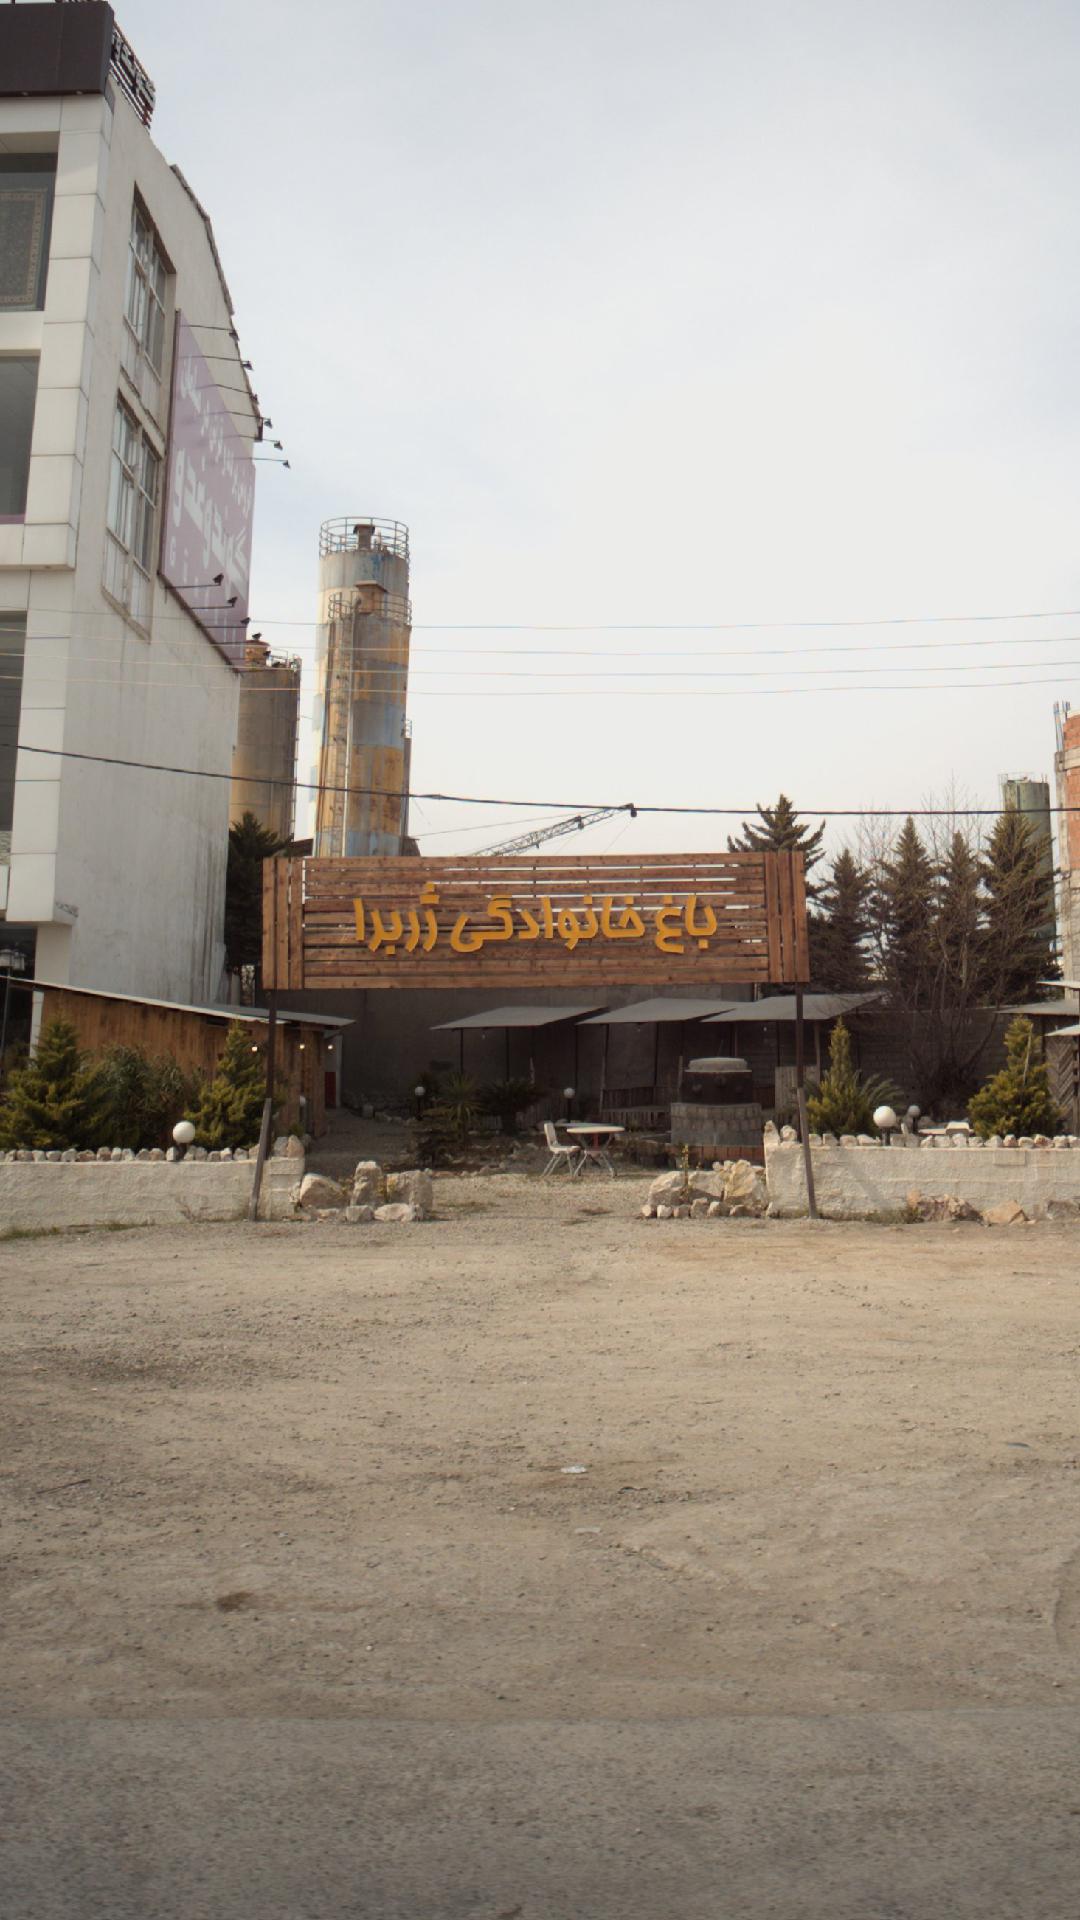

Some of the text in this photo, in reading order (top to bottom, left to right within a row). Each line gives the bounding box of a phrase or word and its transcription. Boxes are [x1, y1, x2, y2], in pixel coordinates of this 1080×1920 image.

[352, 882, 718, 956] باغ خانوادگی ژربرا
